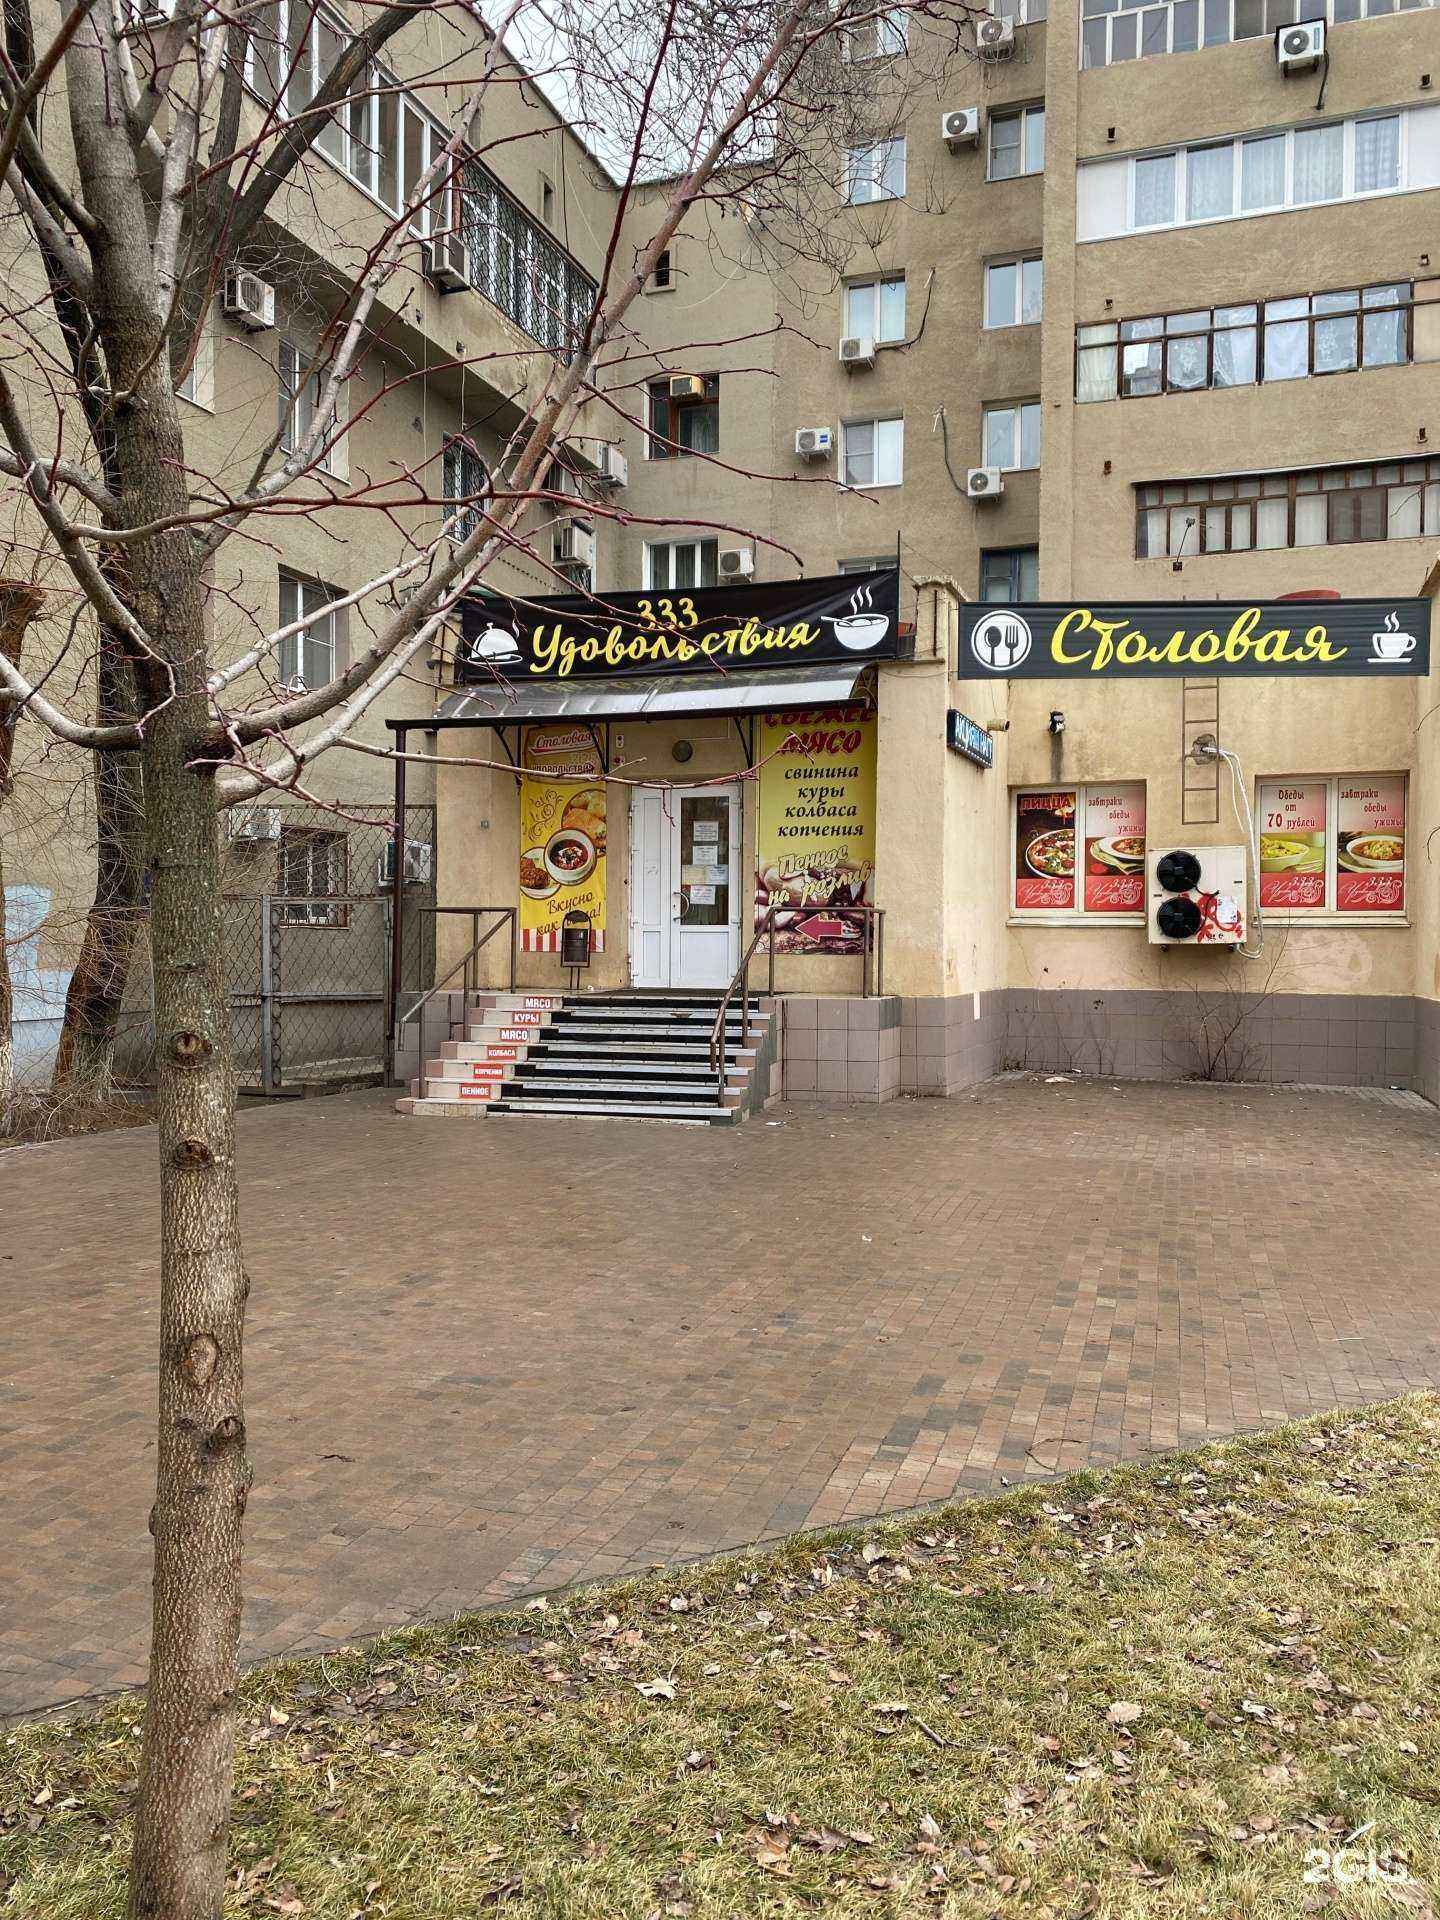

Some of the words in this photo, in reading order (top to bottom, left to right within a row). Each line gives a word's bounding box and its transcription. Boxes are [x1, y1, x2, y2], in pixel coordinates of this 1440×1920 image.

[637, 597, 699, 631] 333
[530, 616, 822, 676] Удовольствия
[1051, 608, 1348, 671] Столовая
[784, 765, 859, 780] свинина
[797, 785, 845, 804] куры
[1278, 789, 1305, 800] Обеды
[785, 799, 857, 818] колбаса
[1267, 813, 1283, 828] 70
[777, 823, 864, 837] копчения
[547, 892, 593, 914] Вкусно
[536, 920, 561, 936] как
[525, 998, 551, 1009] МЯСО
[513, 1013, 540, 1023] КУРЫ
[501, 1030, 528, 1041] МЯСО
[461, 1086, 489, 1096] ПЕННОЕ
